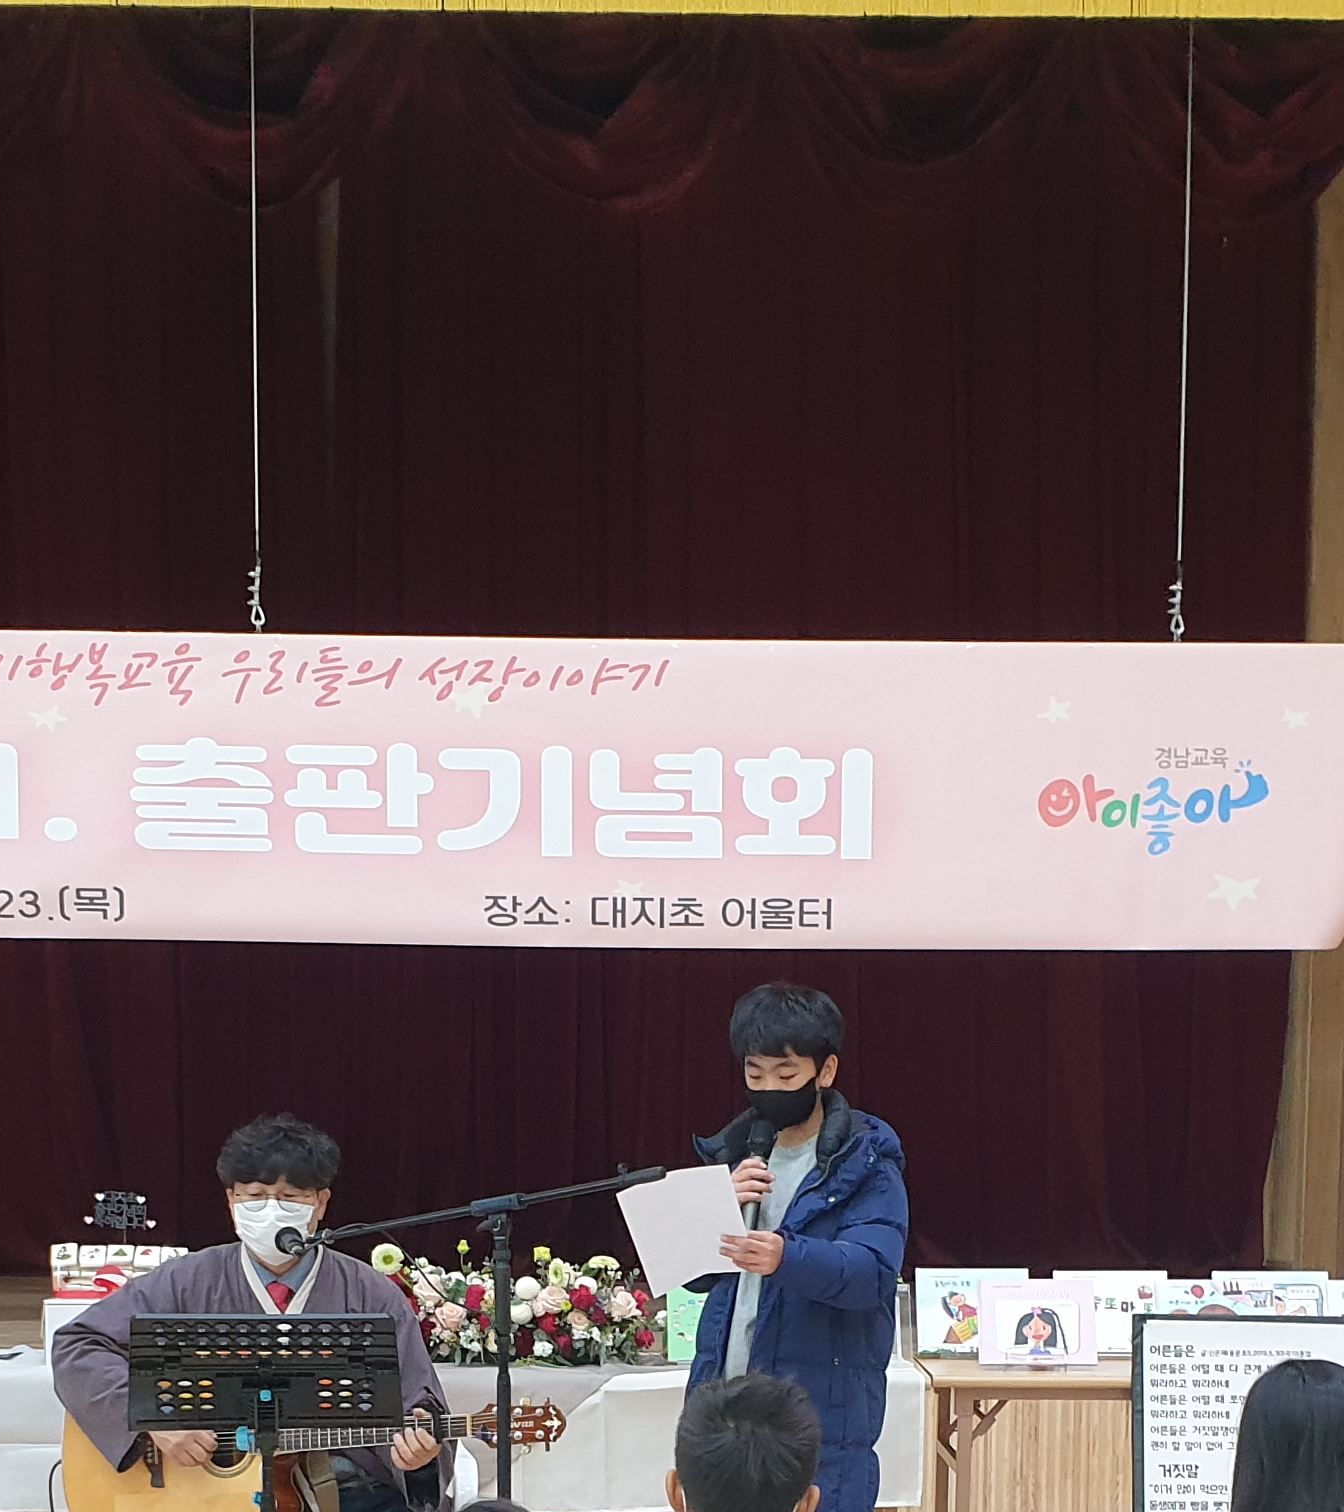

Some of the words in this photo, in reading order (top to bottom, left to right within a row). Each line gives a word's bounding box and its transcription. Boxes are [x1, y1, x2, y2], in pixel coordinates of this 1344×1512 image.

[223, 648, 404, 708] 우리들의
[419, 655, 669, 703] 성장이야기
[1155, 747, 1228, 769] 경남교육
[130, 737, 873, 859] 출판기념회
[1038, 772, 1269, 855] 아이좋아
[483, 895, 571, 927] 장소:
[591, 896, 705, 929] 대지초
[721, 897, 832, 930] 어울터
[1149, 1344, 1196, 1358] 어른들은
[1149, 1363, 1187, 1375] 어른들은
[1229, 1364, 1239, 1374] 다
[1150, 1378, 1187, 1389] 뭐라하고
[1149, 1394, 1187, 1406] 어른들은
[1150, 1409, 1187, 1420] 뭐라하고
[1150, 1425, 1187, 1437] 어른들은
[1158, 1464, 1199, 1478] 거짓말
[1176, 1484, 1196, 1495] 많이
